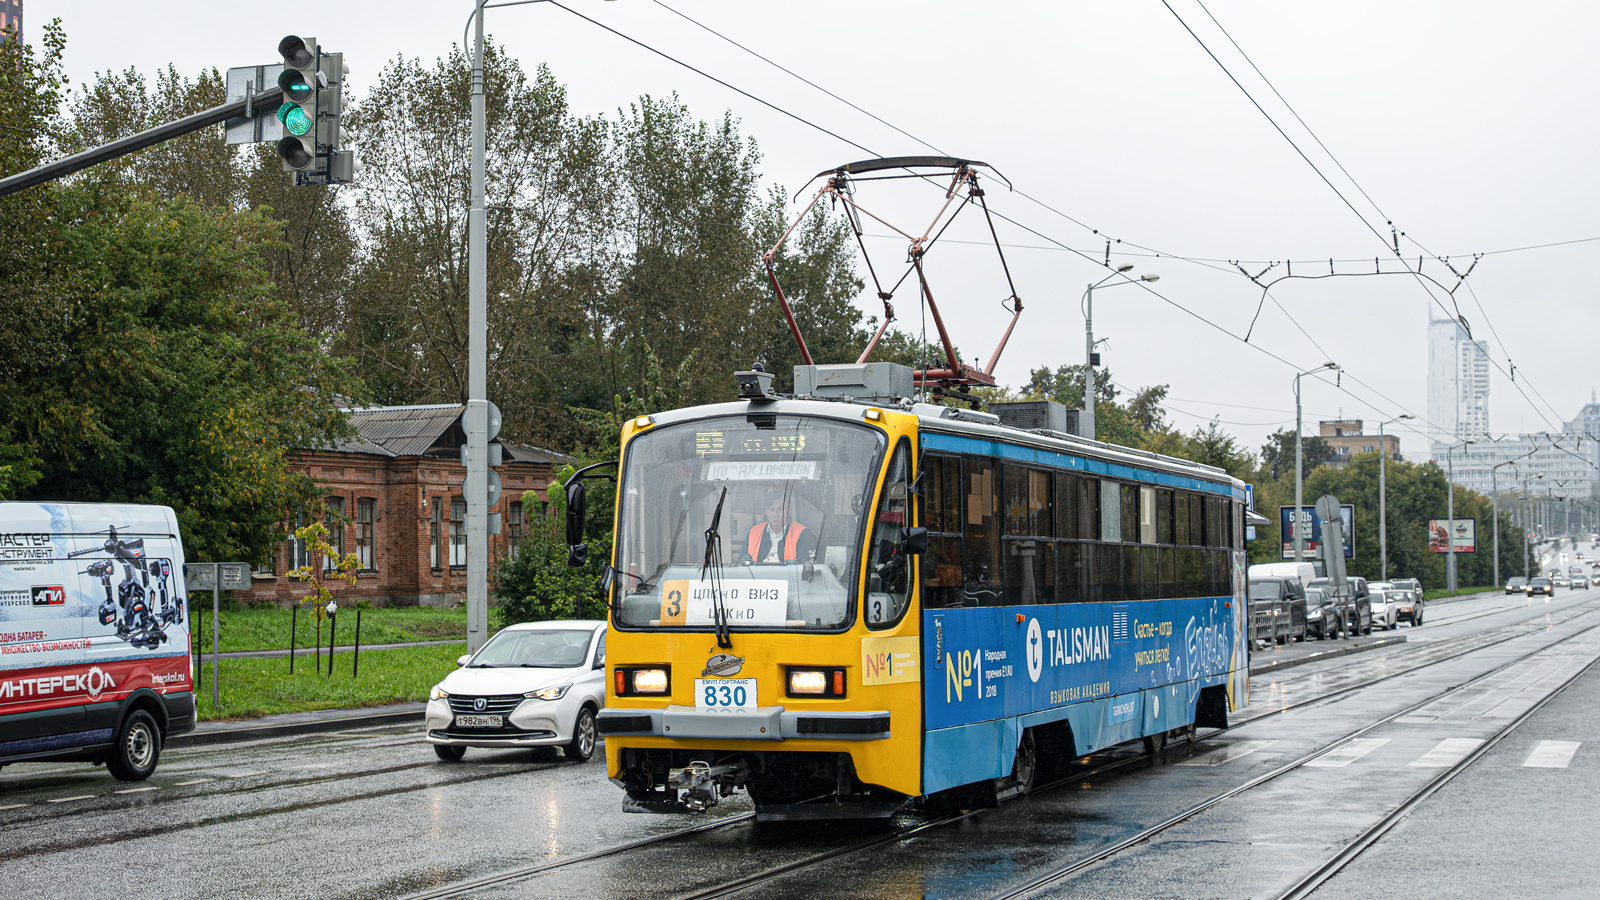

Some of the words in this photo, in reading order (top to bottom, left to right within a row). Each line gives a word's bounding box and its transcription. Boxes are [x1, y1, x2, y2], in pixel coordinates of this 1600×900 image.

[1289, 511, 1312, 522] БДЬ
[35, 589, 63, 602] АПИ
[667, 590, 681, 617] 3
[748, 588, 779, 600] ВИЗ
[873, 601, 881, 622] 3
[18, 630, 43, 641] БАТАРЕЯ
[1134, 618, 1154, 639] Счастье
[1159, 620, 1173, 638] когда
[1, 643, 41, 655] МНОЖЕСТВО
[1135, 648, 1154, 672] учиться
[151, 671, 184, 684] interskol.ru
[705, 686, 746, 706] 830
[1050, 686, 1080, 704] ЯЗЫКОВАЯ
[1082, 681, 1110, 699] АКАДЕМИЯ
